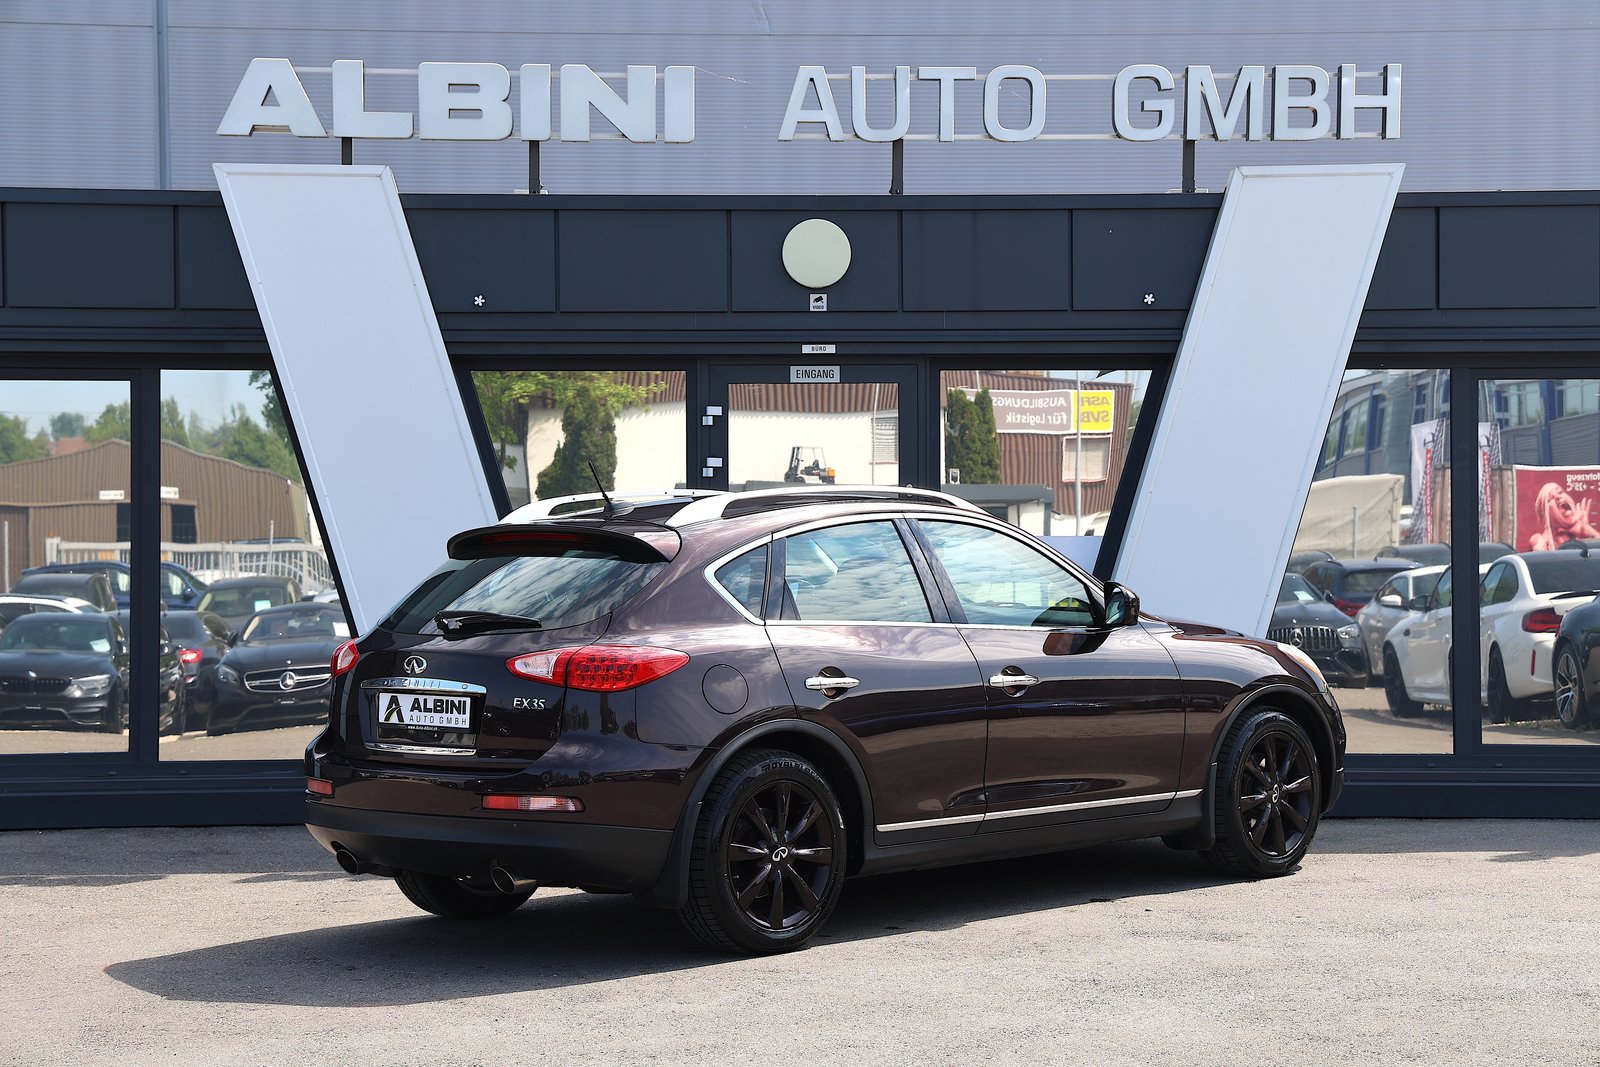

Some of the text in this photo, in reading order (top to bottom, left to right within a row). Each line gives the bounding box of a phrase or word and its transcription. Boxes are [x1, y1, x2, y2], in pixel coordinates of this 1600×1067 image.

[216, 58, 1402, 143] ALBINI AUTO GMBH
[796, 369, 835, 379] EINGANG
[409, 697, 467, 715] ALBINI
[513, 697, 546, 710] EX35
[409, 714, 467, 726] AUTO GMBH
